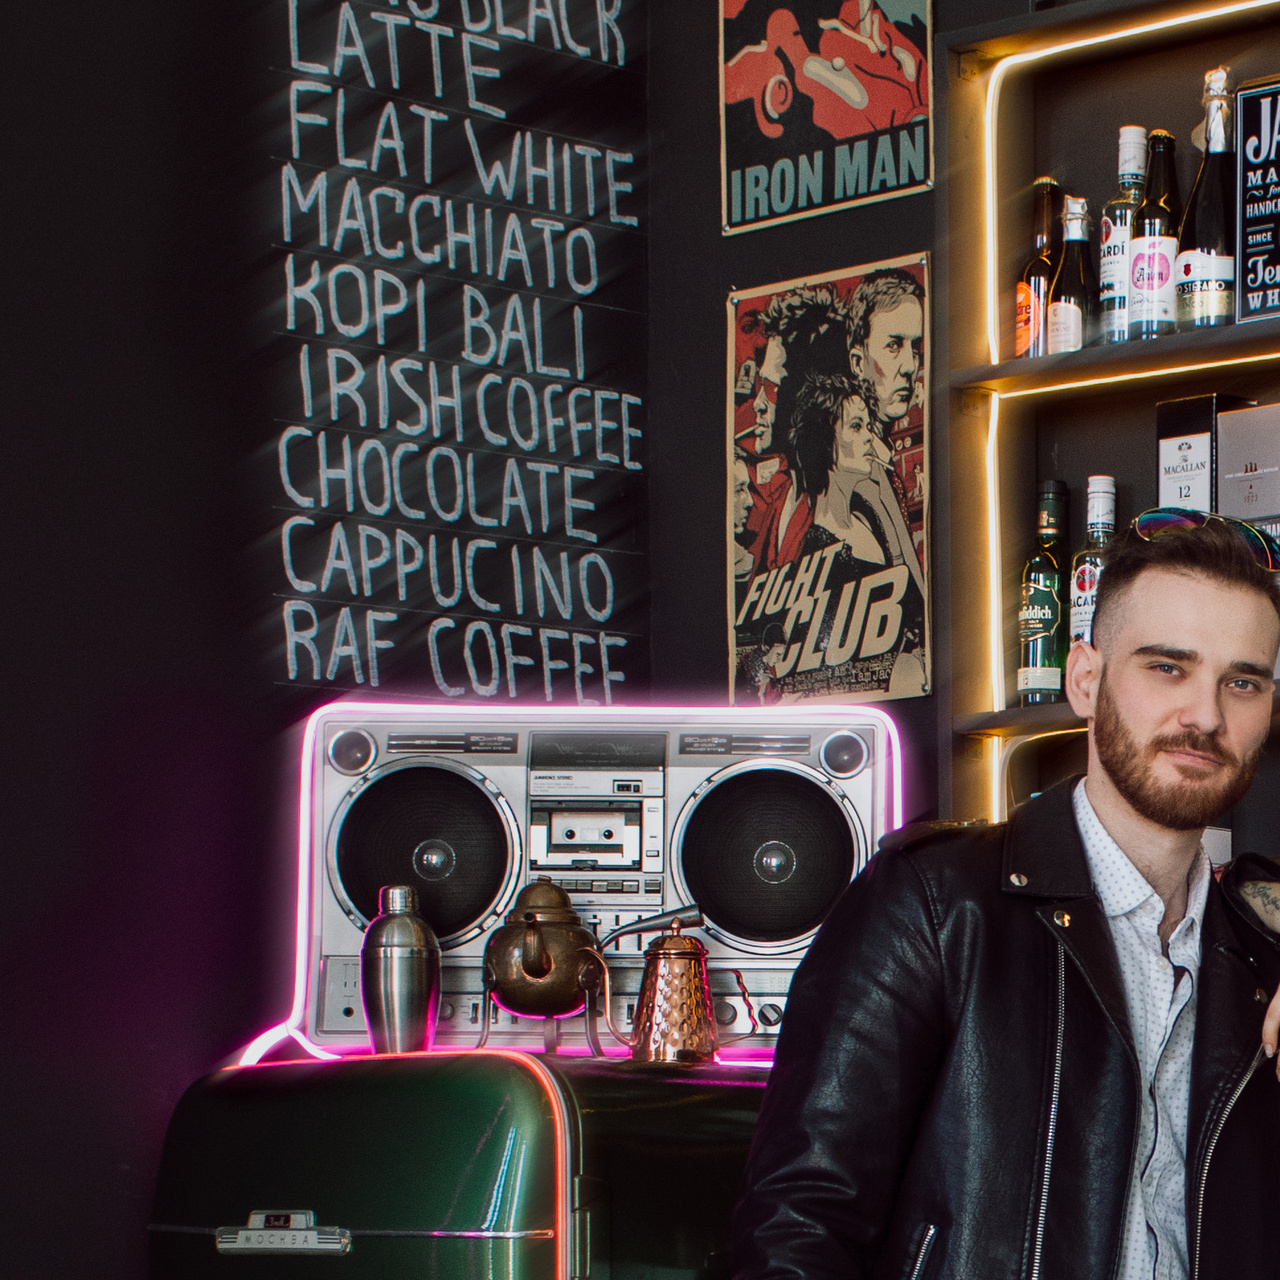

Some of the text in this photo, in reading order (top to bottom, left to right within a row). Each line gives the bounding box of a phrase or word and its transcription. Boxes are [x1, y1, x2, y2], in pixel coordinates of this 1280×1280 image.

[287, 0, 506, 119] LATTE
[289, 79, 639, 227] FLAT WHITE
[731, 125, 925, 224] IRON MAN
[281, 161, 599, 296] MACCHIATO
[1247, 231, 1273, 245] SINCE
[284, 252, 585, 381] KOPI BALI
[299, 344, 643, 471] IRISH COFFEE
[278, 426, 599, 543] CHOCOLATE
[1163, 461, 1206, 476] MACALLAN
[1178, 485, 1191, 499] 12
[281, 515, 615, 623] CAPPUCINO
[734, 541, 845, 626] FIGHT
[774, 563, 909, 680] CLUB
[282, 600, 399, 687] RAF
[244, 1234, 310, 1244] МОСКВА
